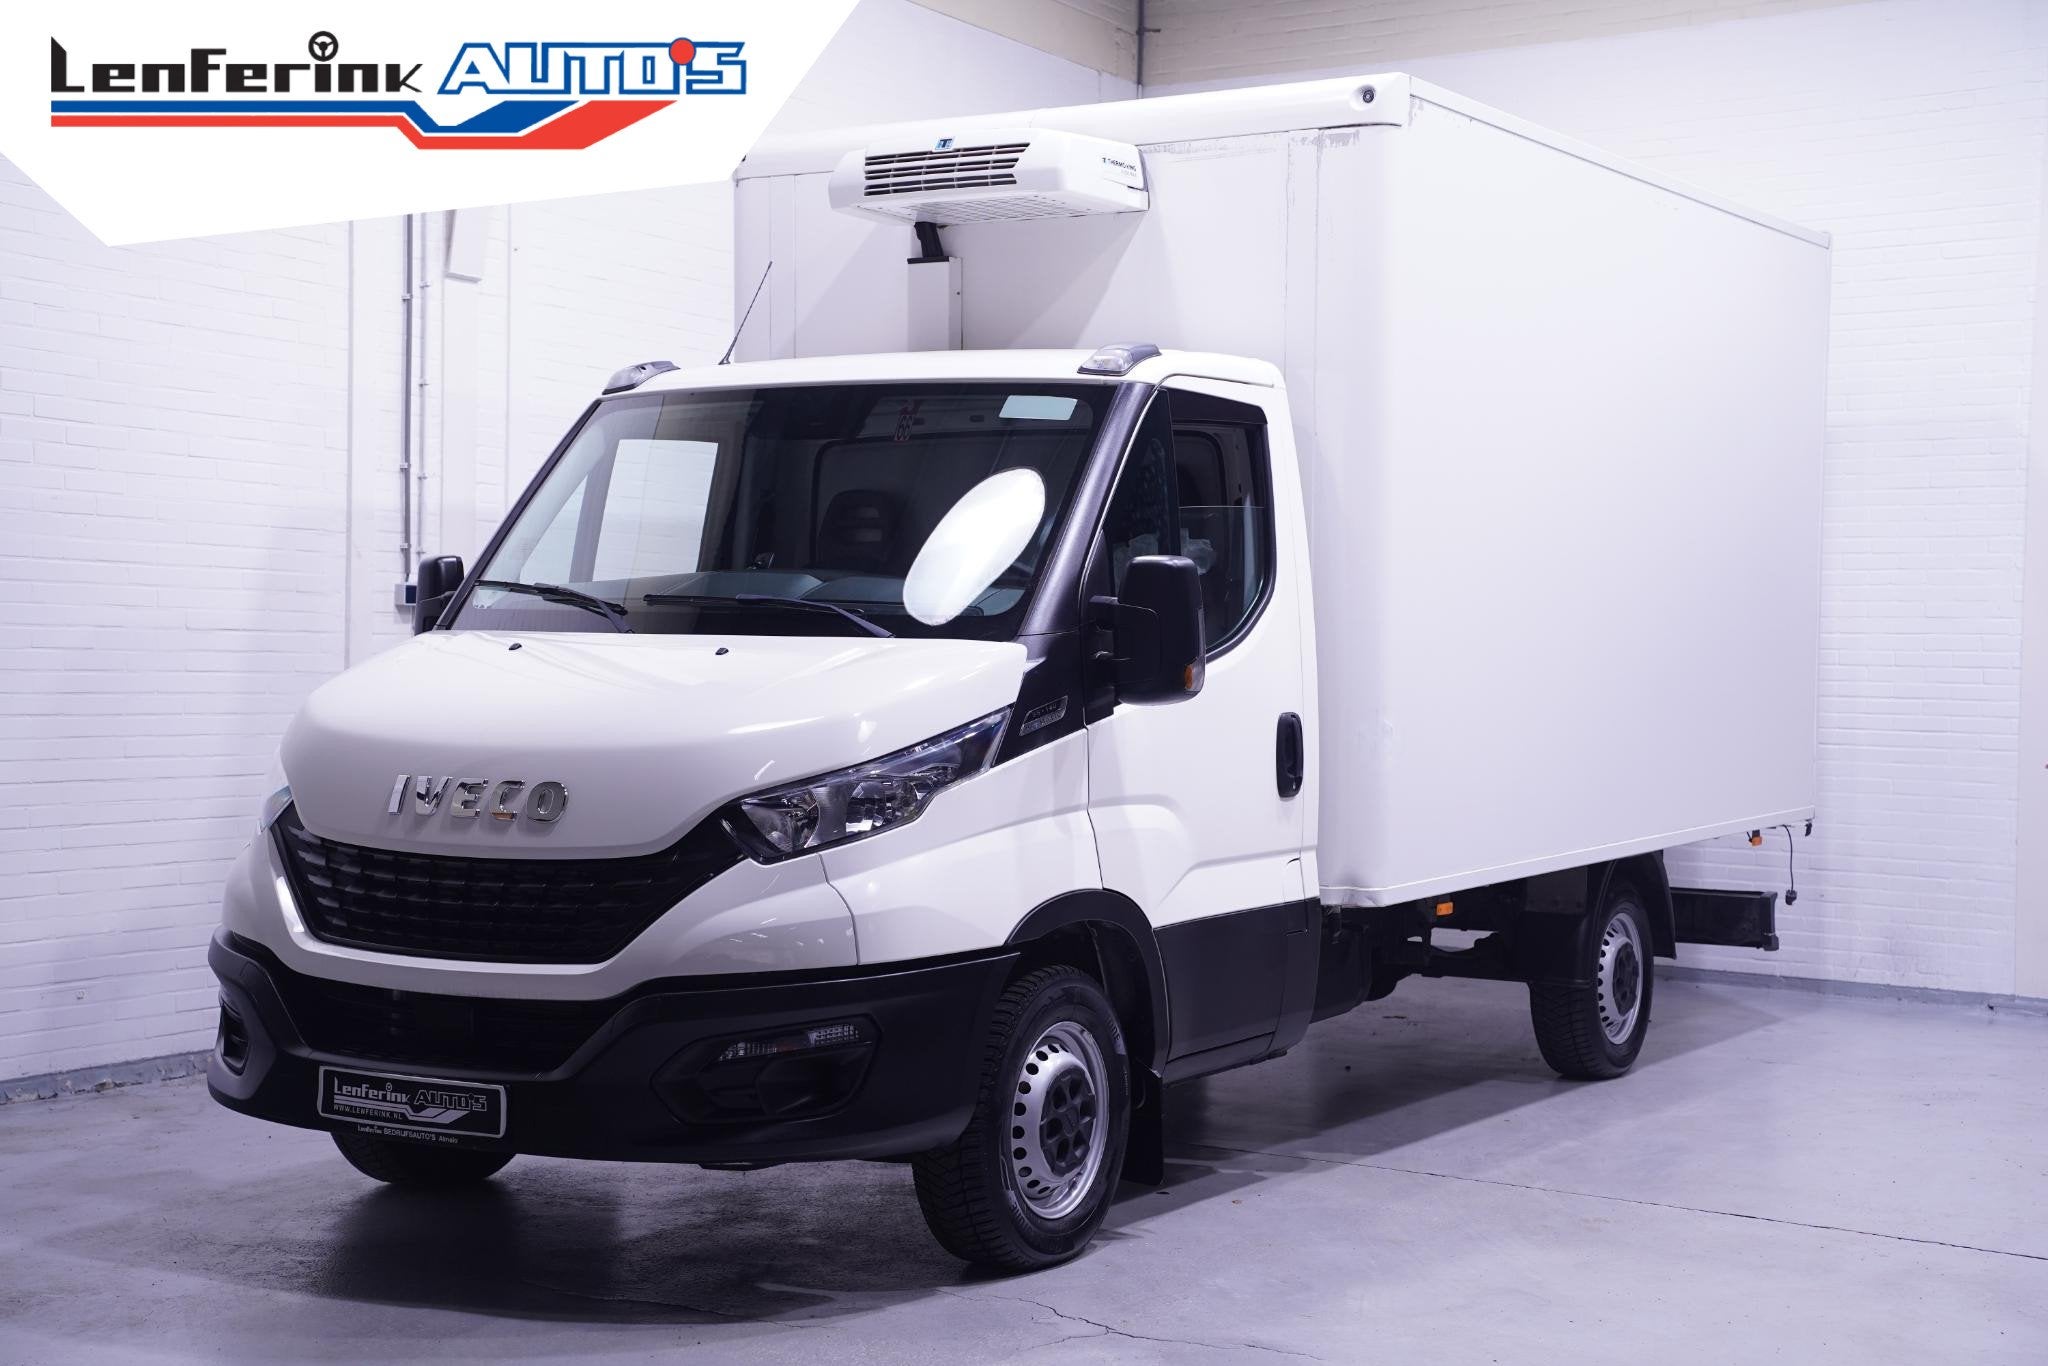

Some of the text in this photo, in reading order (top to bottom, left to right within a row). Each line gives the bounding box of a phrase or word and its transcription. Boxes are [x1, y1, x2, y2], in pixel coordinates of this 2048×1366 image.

[387, 774, 569, 822] IVECO
[333, 1104, 403, 1120] WWW.LENFERINK.NL
[413, 1089, 487, 1112] AUTO'S
